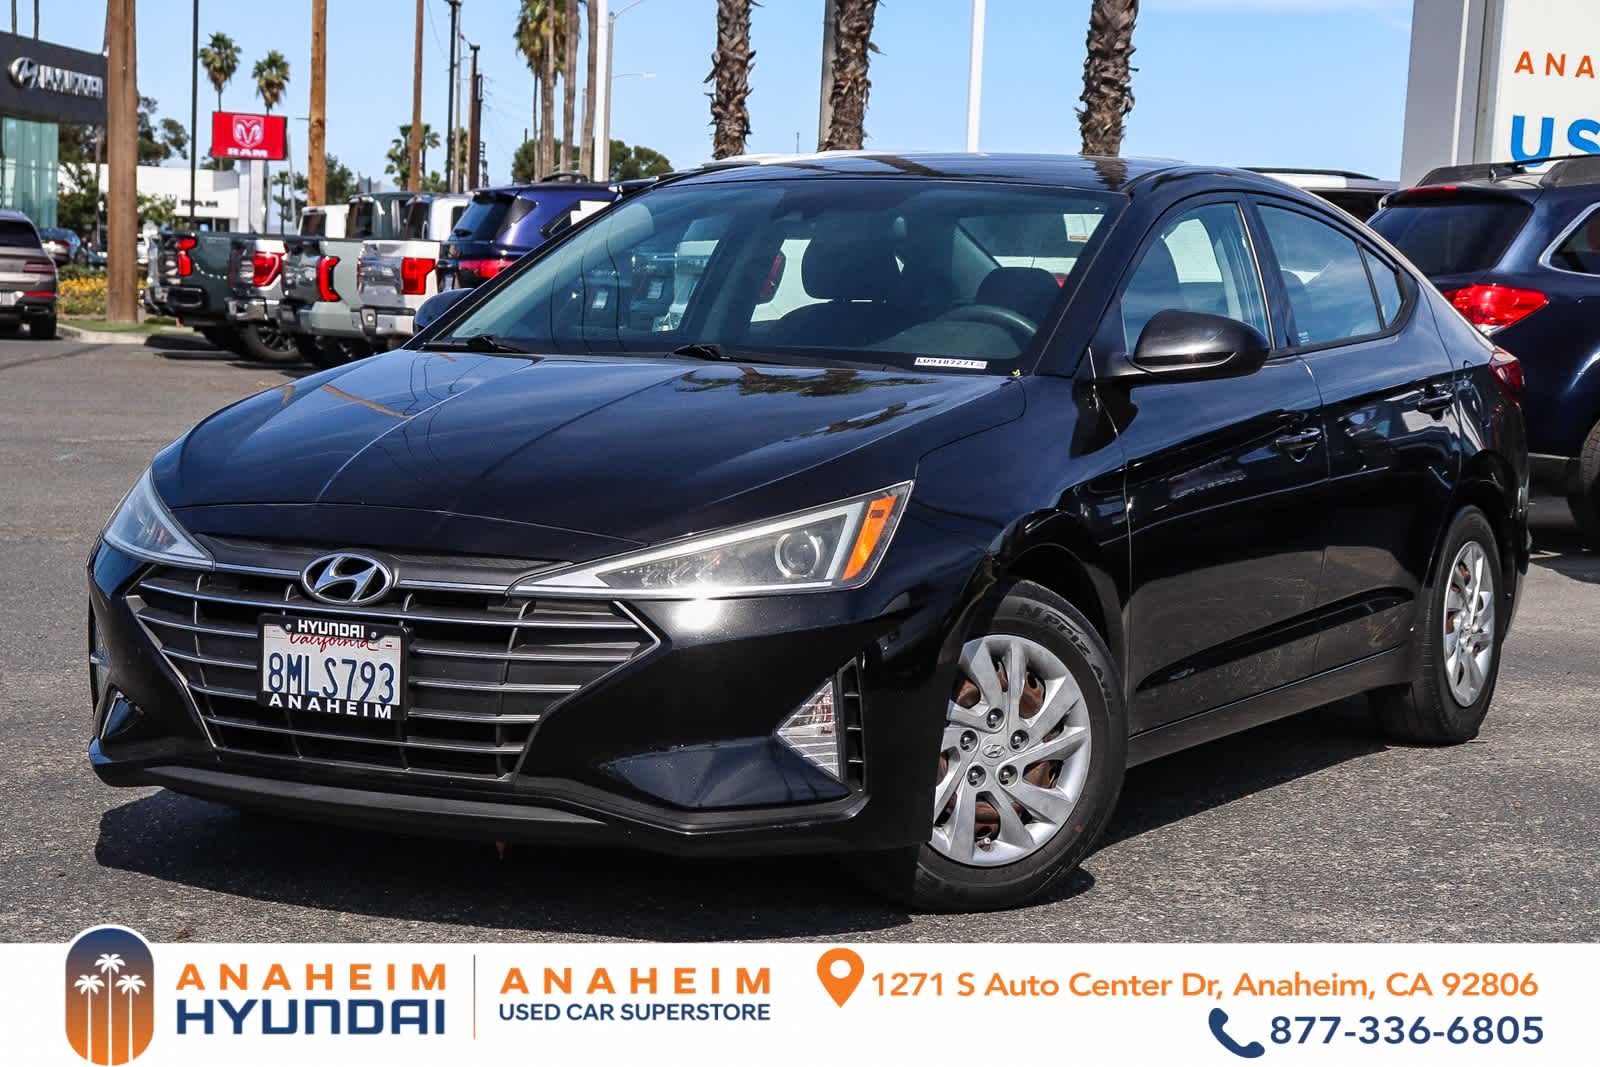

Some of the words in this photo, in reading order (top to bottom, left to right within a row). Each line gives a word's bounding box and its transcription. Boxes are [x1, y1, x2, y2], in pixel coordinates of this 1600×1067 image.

[227, 147, 269, 158] RAM
[298, 619, 365, 638] HYUNDAI
[289, 632, 379, 652] California
[268, 652, 395, 704] 8MLS793
[269, 693, 392, 720] ANAHEIM
